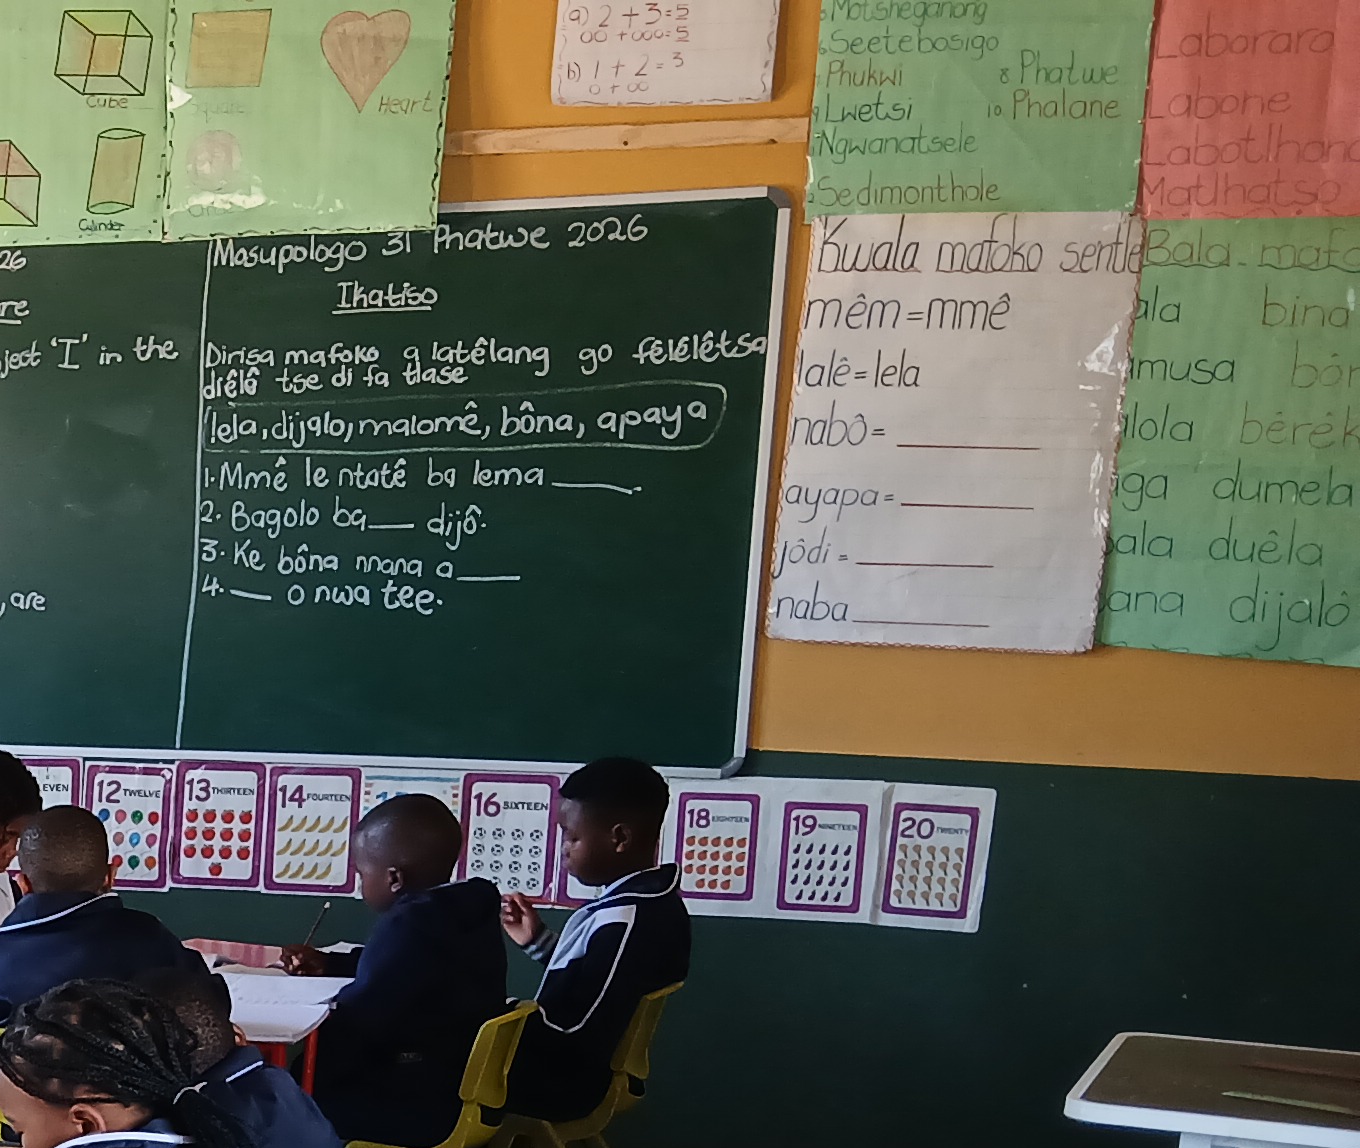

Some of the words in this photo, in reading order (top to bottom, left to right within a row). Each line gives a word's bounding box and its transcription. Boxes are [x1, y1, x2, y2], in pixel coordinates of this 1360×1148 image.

[831, 25, 999, 60] Seetebosigo
[826, 58, 903, 88] Phukwi
[1020, 49, 1118, 85] Phatwe
[86, 95, 128, 109] Cube
[379, 96, 433, 114] Heart
[825, 91, 912, 123] Lwetsi
[1013, 89, 1122, 120] Phalane
[1148, 75, 1292, 119] Labone
[817, 167, 1001, 207] Sedimonthole
[381, 231, 411, 256] 31
[567, 213, 649, 248] 2026
[817, 214, 922, 272] Kwala
[936, 213, 1043, 273] mafoko
[1262, 283, 1350, 327] bina
[99, 345, 122, 365] in
[132, 335, 179, 361] the
[205, 342, 275, 368] Dirisa
[285, 343, 380, 367] mafoko
[403, 346, 419, 363] a
[431, 337, 550, 376] latêlang
[579, 344, 613, 375] go
[275, 368, 323, 393] tse
[331, 364, 353, 387] di
[363, 365, 390, 387] fa
[402, 362, 469, 385] tlase
[597, 400, 707, 440] apaya
[306, 457, 329, 487] le
[338, 458, 406, 489] ntatê
[427, 457, 455, 487] ba
[472, 459, 544, 487] lema
[231, 498, 319, 539] Bagolo
[333, 495, 367, 532] ba
[1208, 517, 1323, 567] duêla
[233, 539, 266, 571] Ke
[277, 543, 339, 575] bôna
[436, 562, 453, 578] a
[10, 592, 46, 611] are
[314, 585, 370, 606] nwa
[776, 580, 848, 622] naba
[96, 780, 122, 804] 12
[123, 788, 162, 800] TWELVE
[185, 778, 212, 803] 13
[211, 786, 255, 797] THIRTEEN
[279, 784, 307, 809] 14
[306, 792, 351, 803] FOURTEEN
[473, 792, 501, 818] 16
[502, 801, 548, 811] SIXTEEN
[792, 814, 818, 837] 19
[899, 817, 935, 840] 20
